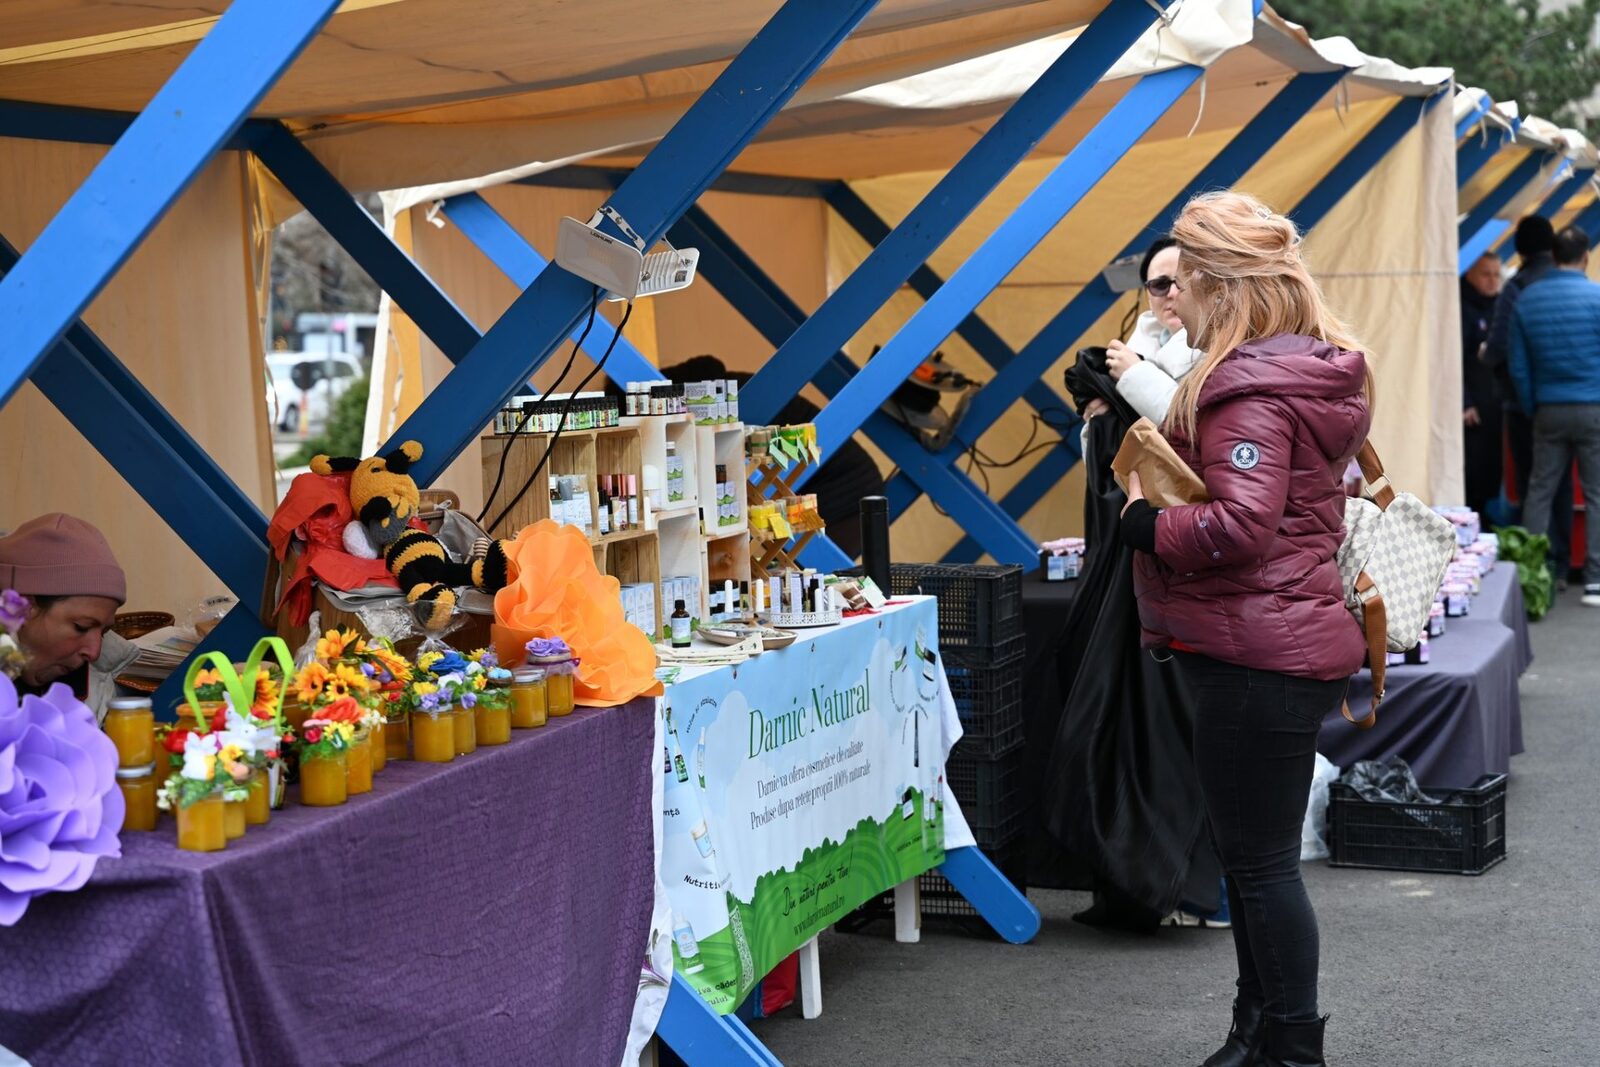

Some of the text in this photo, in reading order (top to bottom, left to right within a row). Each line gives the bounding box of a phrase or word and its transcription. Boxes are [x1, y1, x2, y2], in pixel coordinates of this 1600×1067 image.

[748, 697, 806, 759] Darnic
[810, 668, 870, 733] Natural
[750, 805, 777, 830] Produse
[777, 798, 794, 818] dupa
[811, 777, 832, 805] proprii
[849, 759, 872, 784] naturale
[757, 775, 780, 799] Darnic
[780, 775, 788, 788] va
[788, 764, 805, 784] ofera
[805, 752, 835, 777] cosmetice
[836, 746, 845, 763] de
